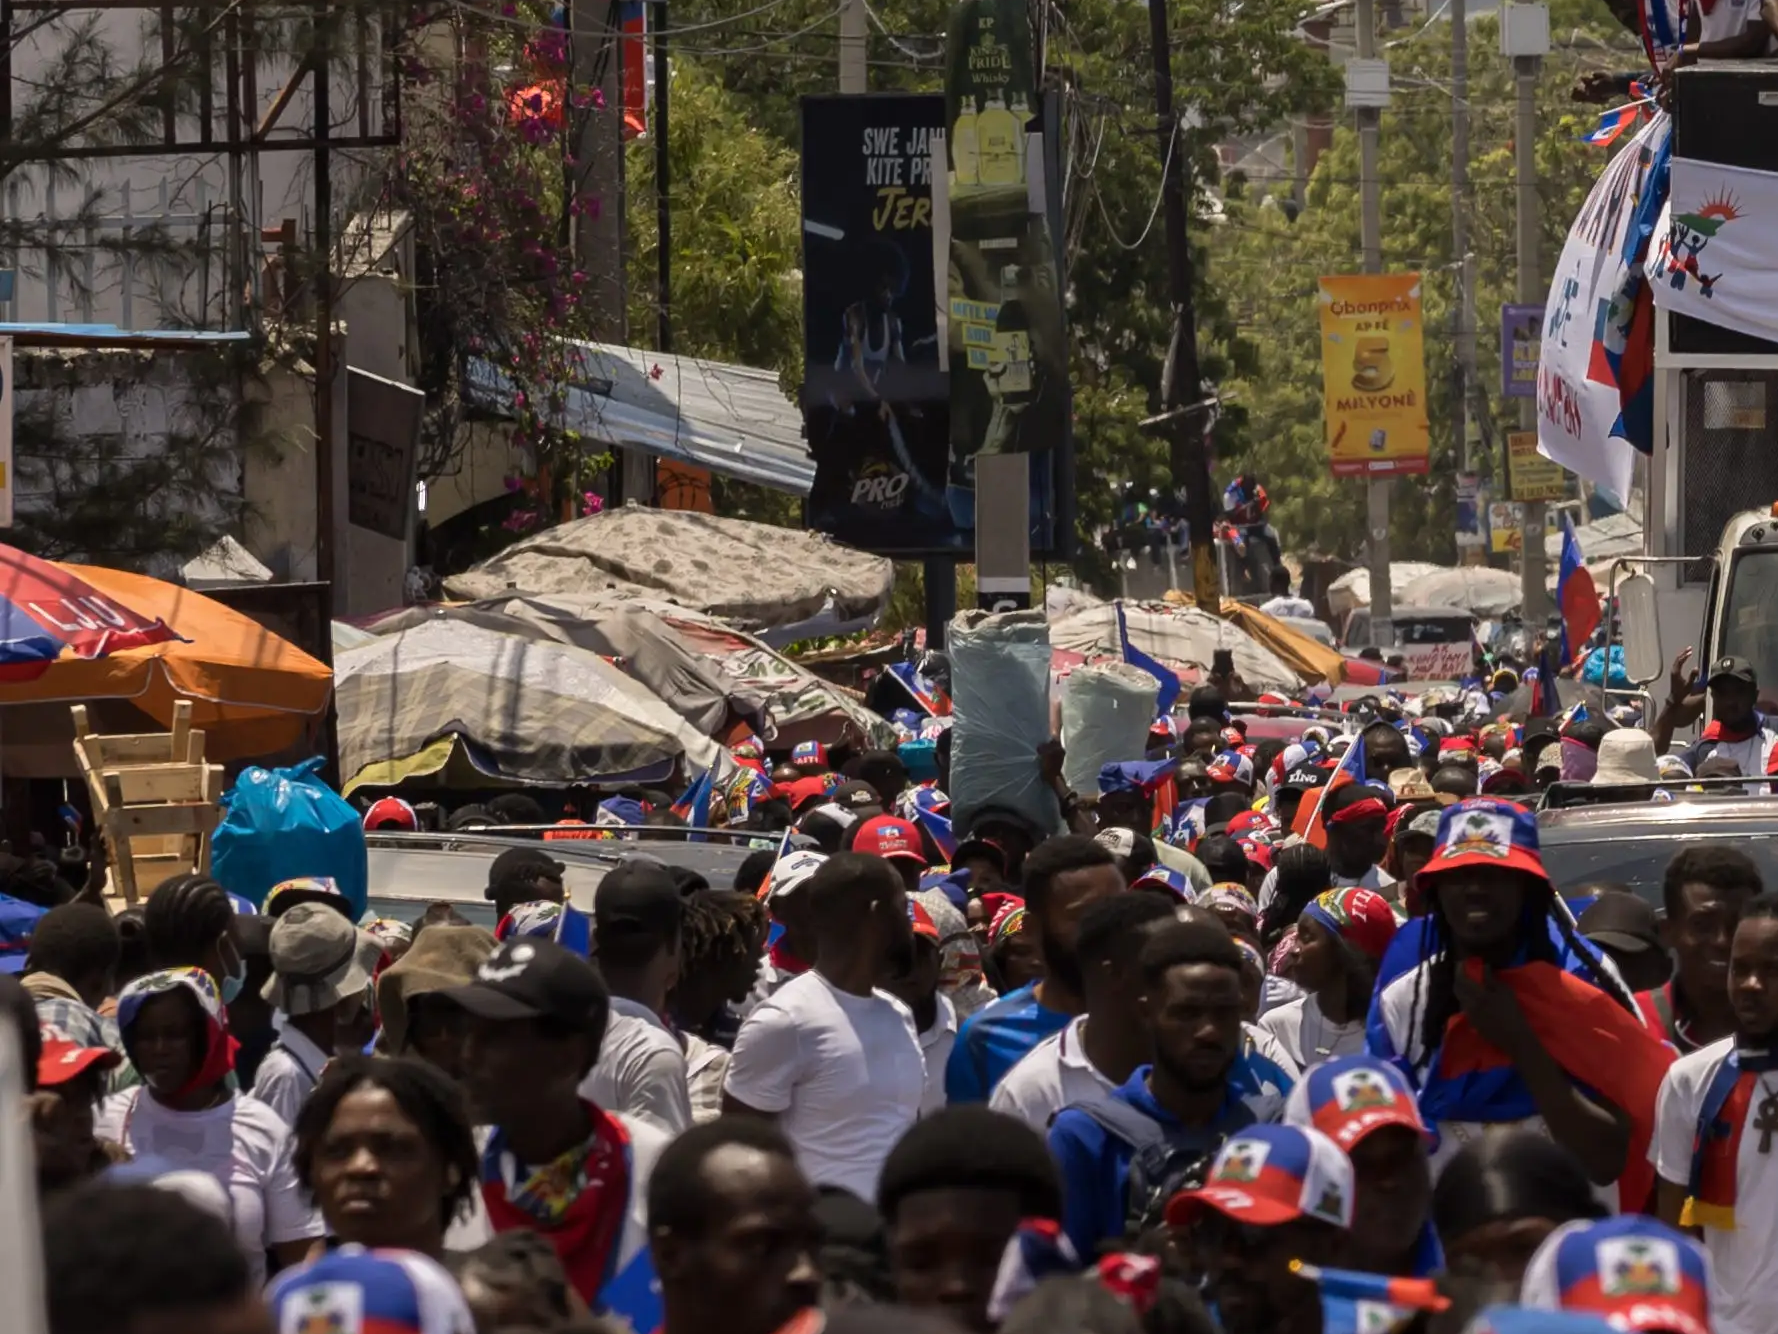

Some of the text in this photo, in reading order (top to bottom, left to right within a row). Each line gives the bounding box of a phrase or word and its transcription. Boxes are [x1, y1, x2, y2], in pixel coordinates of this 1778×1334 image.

[971, 71, 1010, 85] Whisky
[862, 126, 901, 156] SWE
[866, 157, 908, 186] KITE
[1350, 336, 1396, 393] 5
[1336, 388, 1417, 413] MILYONÈ
[850, 471, 908, 505] PRO
